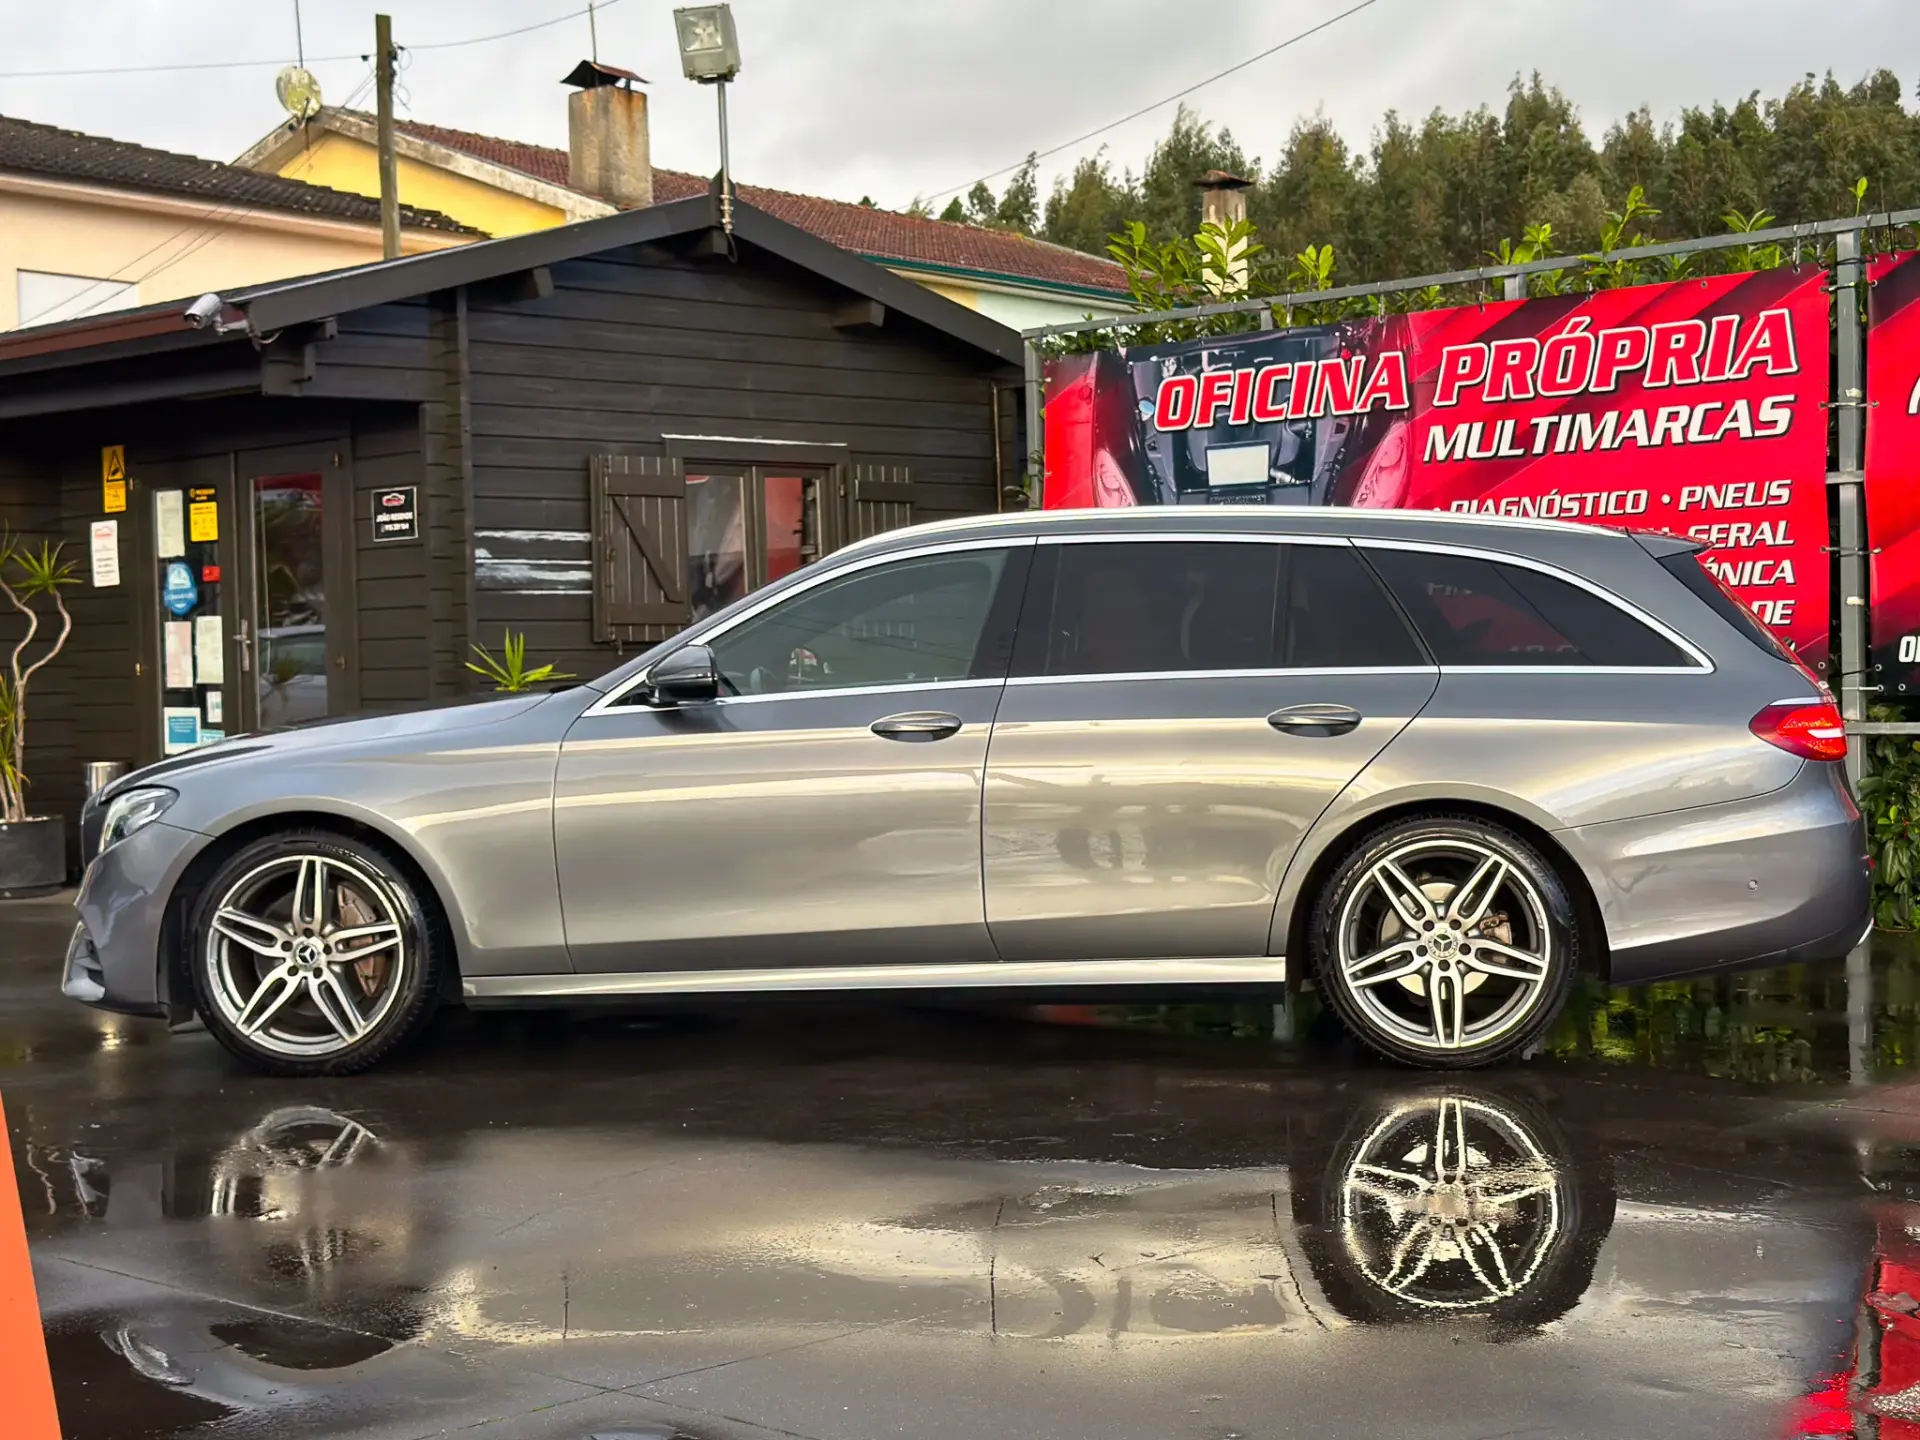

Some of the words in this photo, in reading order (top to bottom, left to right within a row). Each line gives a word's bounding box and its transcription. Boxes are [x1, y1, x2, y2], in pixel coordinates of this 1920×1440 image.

[1154, 351, 1409, 431] OFICINA
[1433, 308, 1798, 407] PRÓPRIA
[1423, 394, 1796, 462] MULTIMARCAS
[1678, 479, 1793, 511] PNEUS
